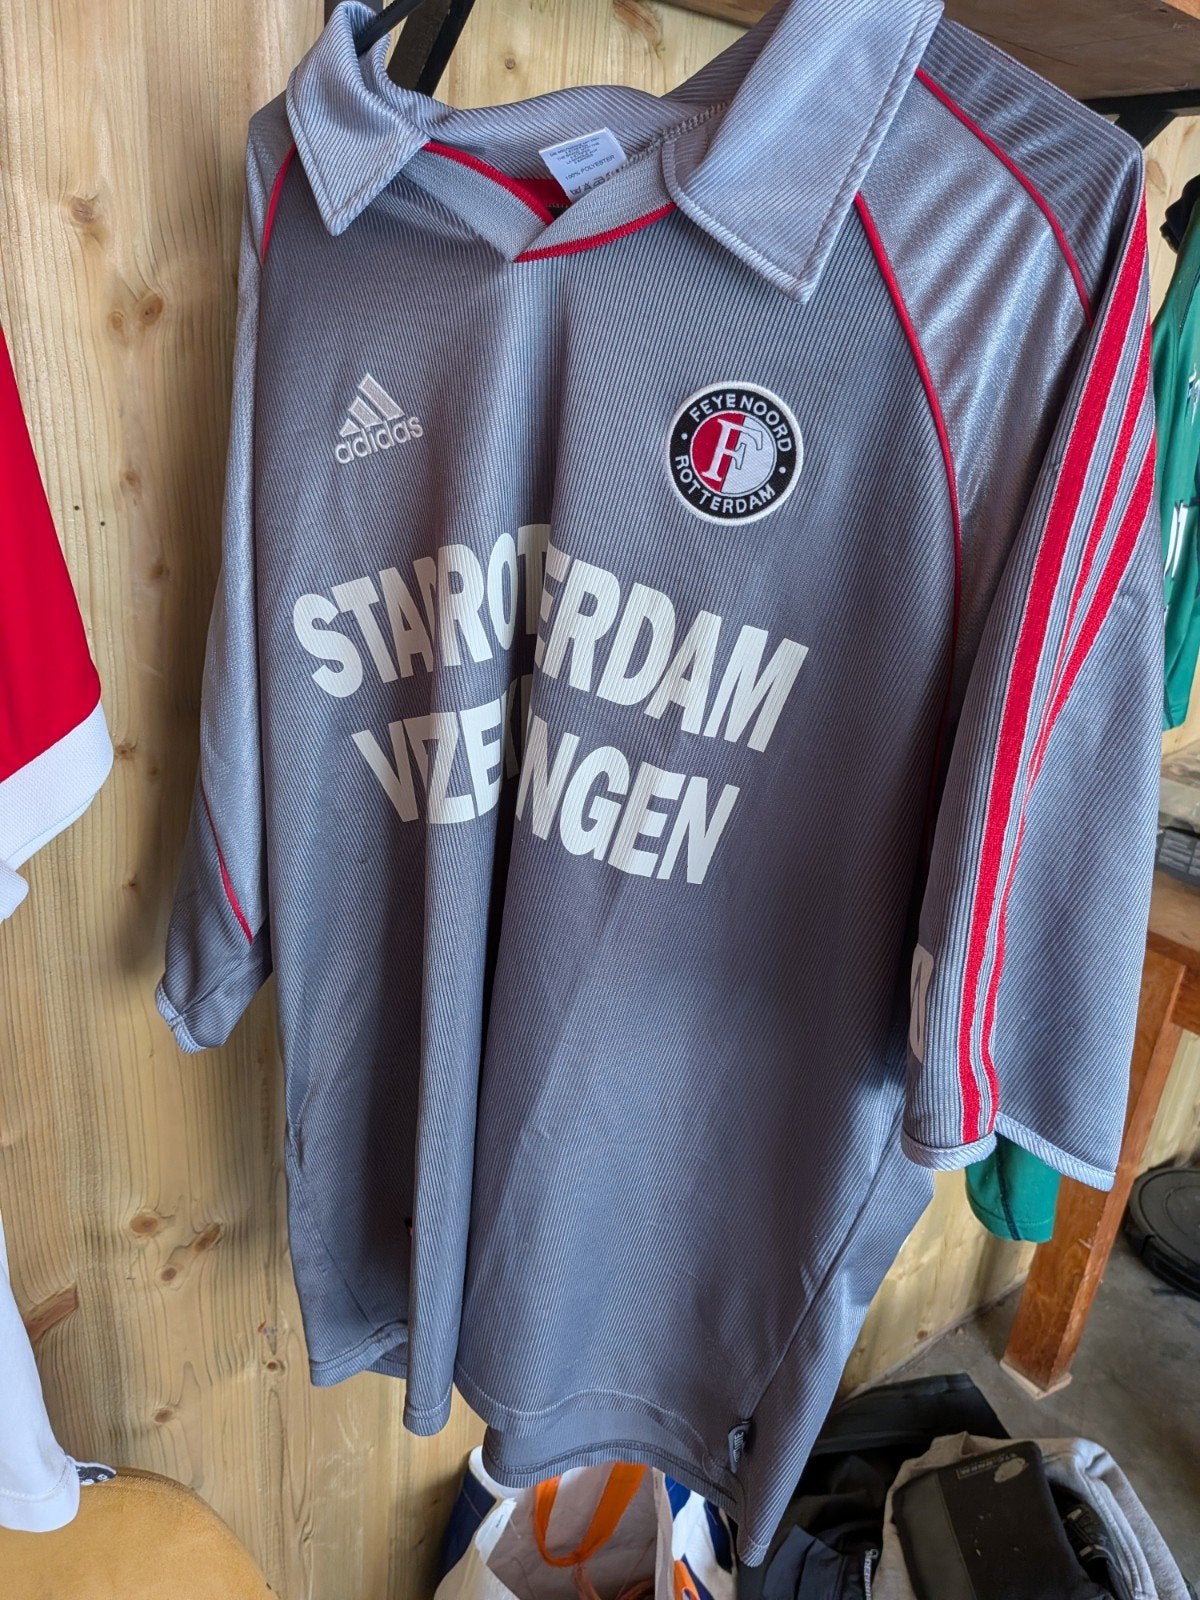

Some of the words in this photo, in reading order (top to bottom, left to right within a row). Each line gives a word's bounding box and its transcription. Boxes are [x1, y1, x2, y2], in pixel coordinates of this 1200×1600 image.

[581, 154, 616, 173] POLYESTER
[335, 416, 423, 464] adidas
[689, 393, 792, 452] FEYENOORD
[675, 454, 776, 514] ROTTERDAM
[437, 523, 809, 753] ROTERDAM
